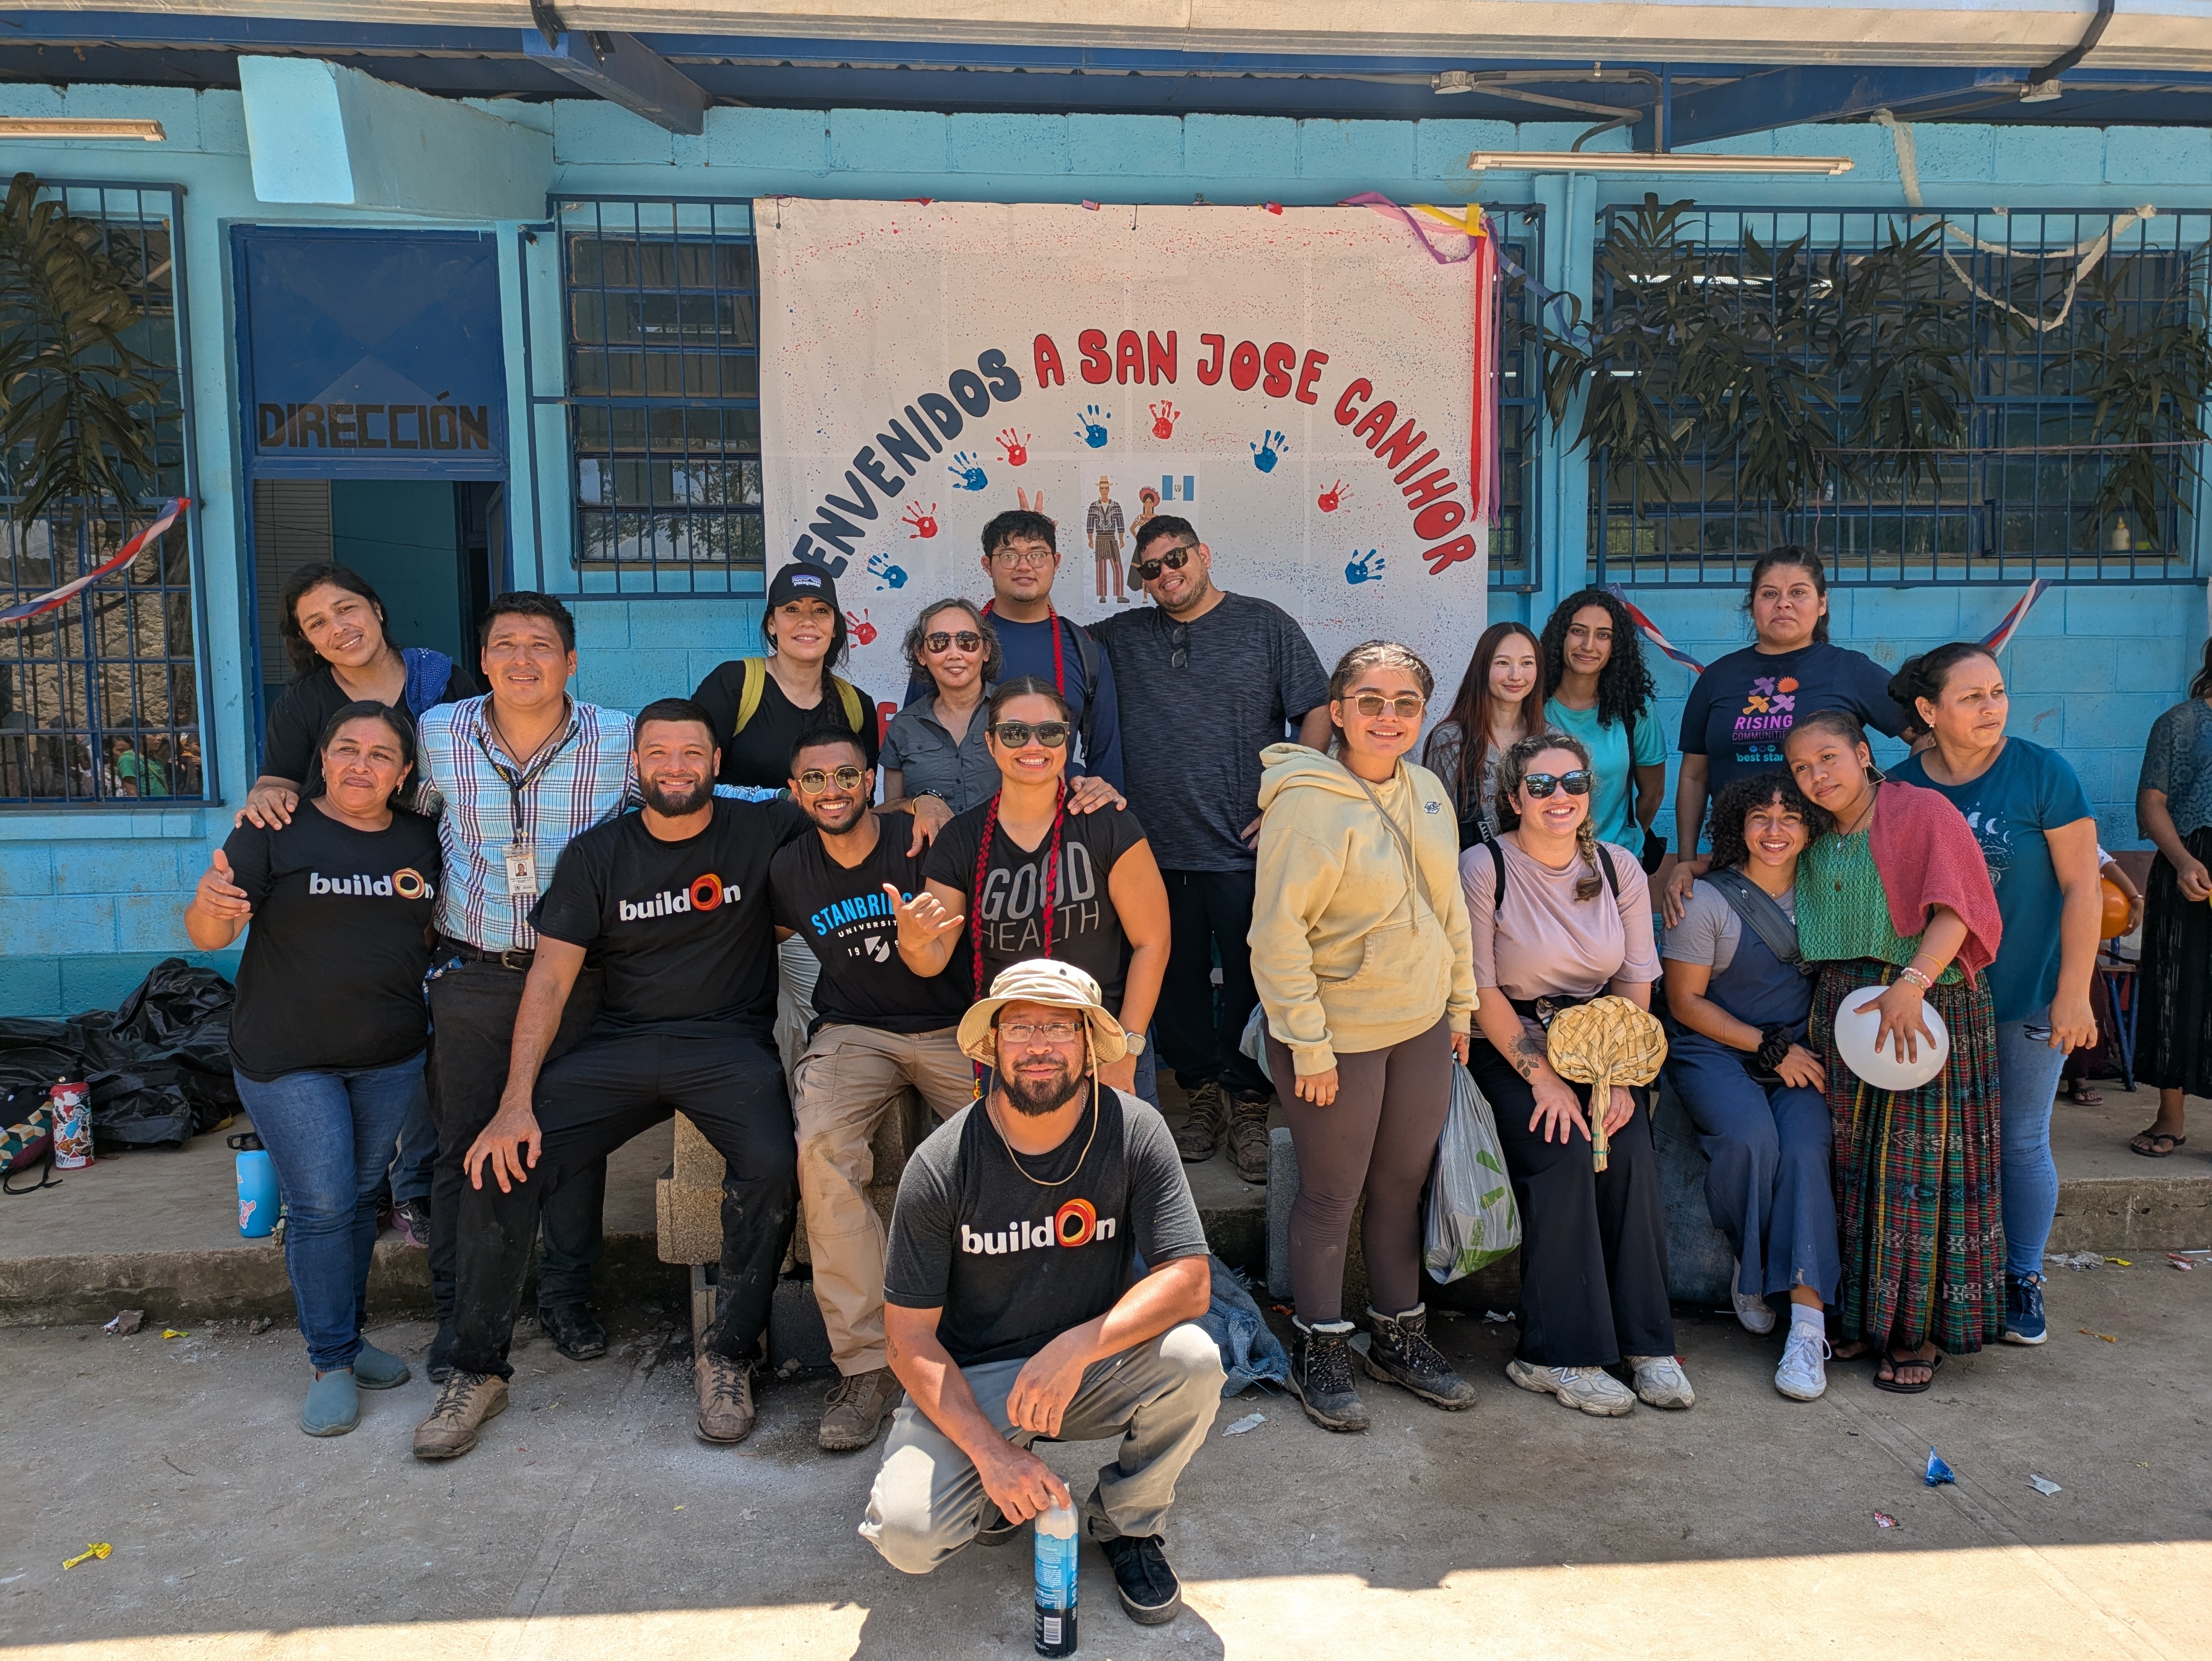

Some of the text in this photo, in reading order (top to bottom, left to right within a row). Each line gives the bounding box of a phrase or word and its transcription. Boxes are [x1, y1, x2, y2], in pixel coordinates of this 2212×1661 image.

[259, 390, 489, 450] DIRECCIÓN
[792, 328, 1477, 578] ENVENIDOS A SAN JOSE CANIHOR
[1732, 730, 1787, 741] COMMUNITIE
[1734, 715, 1793, 730] RISING
[1736, 753, 1784, 762] best star
[309, 867, 434, 899] buildOn
[619, 874, 741, 921] buildOn
[981, 842, 1095, 921] GOOD
[811, 892, 914, 936] STANBRI
[838, 920, 898, 938] UNIVERSIT
[981, 901, 1099, 952] HEATH
[847, 947, 860, 957] 19
[961, 1198, 1116, 1255] buildOn
